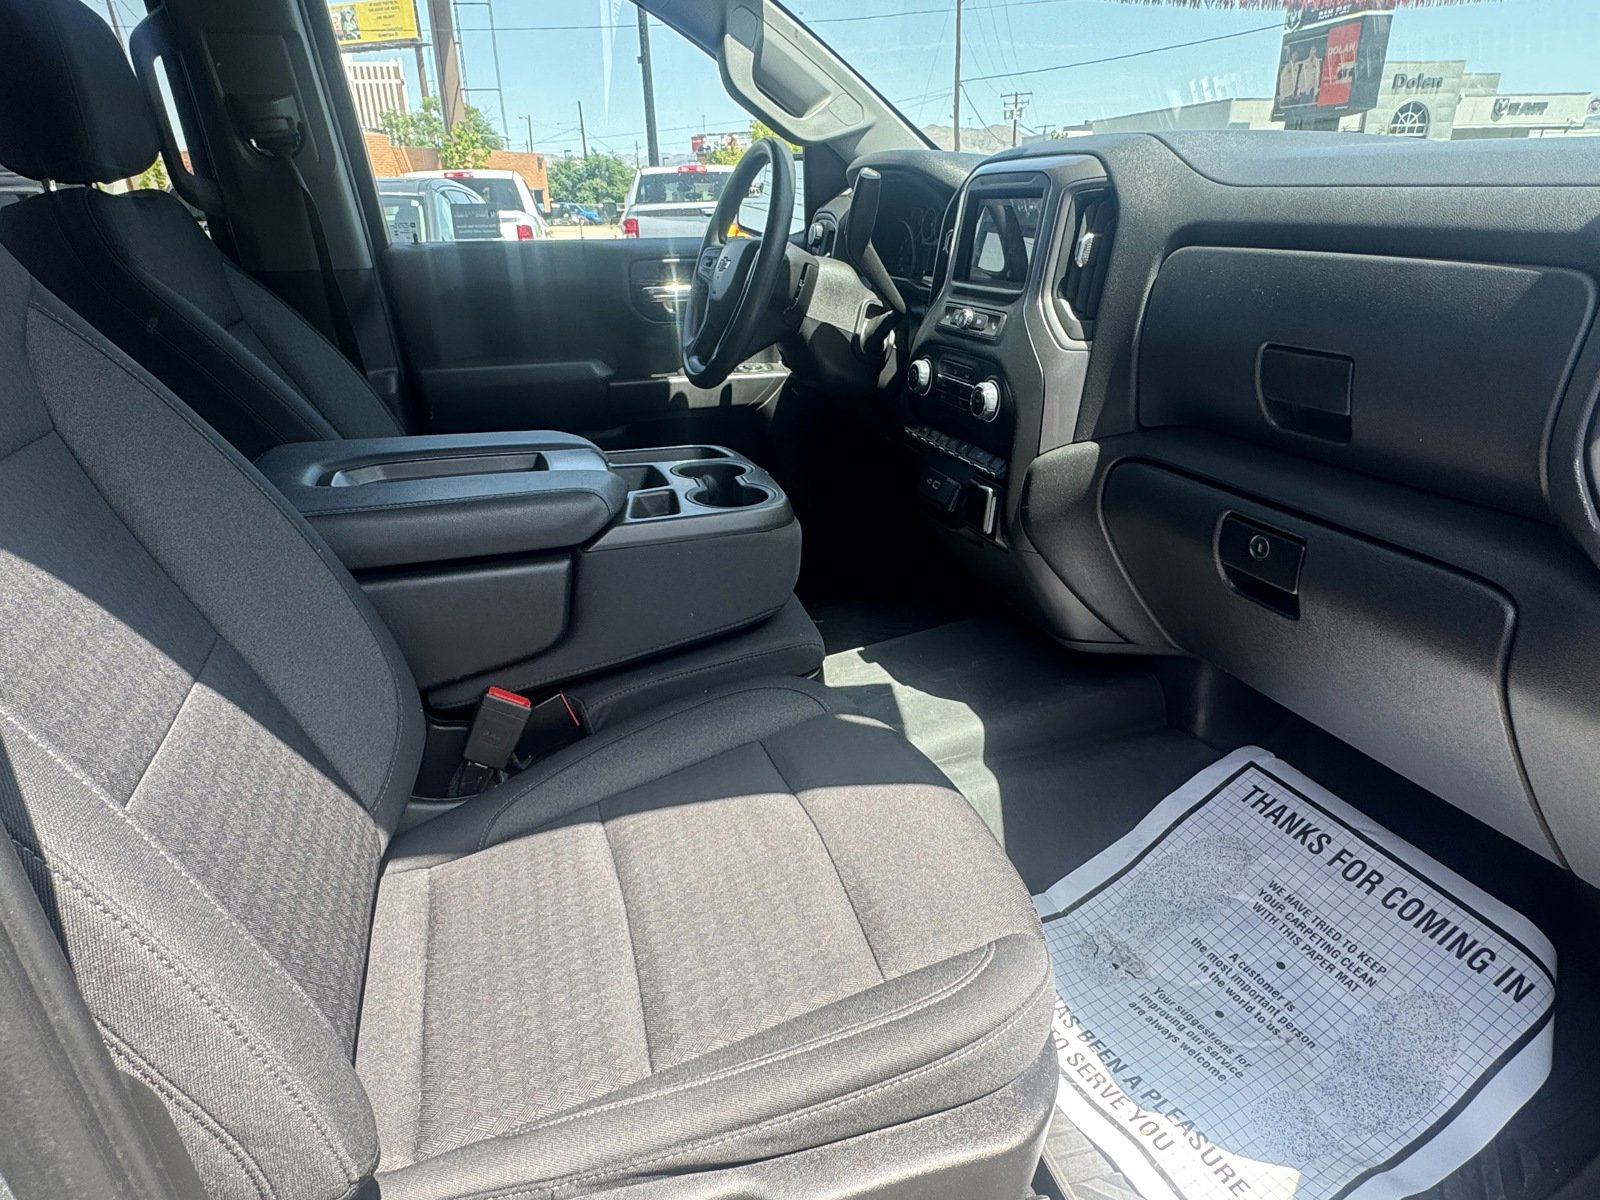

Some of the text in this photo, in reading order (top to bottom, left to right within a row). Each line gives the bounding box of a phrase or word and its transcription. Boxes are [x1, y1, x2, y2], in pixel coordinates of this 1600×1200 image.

[1392, 73, 1443, 89] Dolan
[1242, 785, 1536, 1003] THANKS FOR COMING IN
[1258, 888, 1378, 989] YOUR CARPETING CLEAN
[1268, 880, 1388, 975] WE HAVE TRIED TO KEEP
[1191, 937, 1317, 1050] the most important person
[1229, 952, 1297, 1013] A customer is
[1252, 901, 1362, 994] WITH THIS PAPER MAT
[1128, 1000, 1229, 1086] are always welcome.
[1138, 992, 1245, 1080] improving our service
[1154, 986, 1252, 1069] Your suggestions for
[1198, 961, 1283, 1041] in the world to us.
[1066, 1051, 1132, 1111] SERVE
[1127, 1104, 1176, 1152] YOU
[1076, 1028, 1130, 1075] BEEN
[1123, 1075, 1143, 1090] A
[1140, 1087, 1252, 1198] PLEASURE
